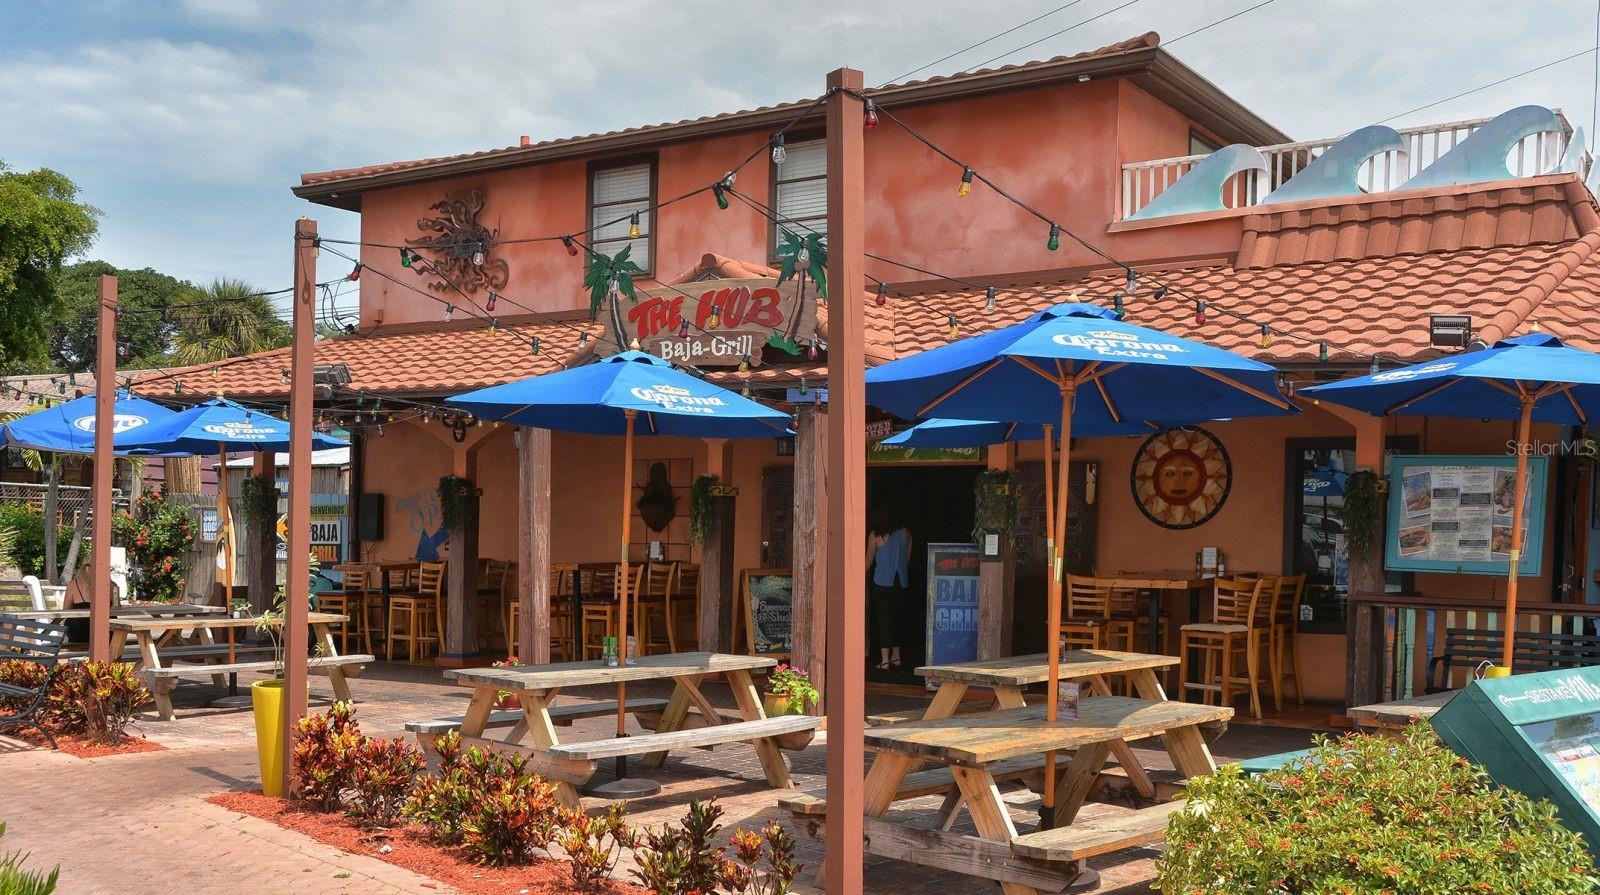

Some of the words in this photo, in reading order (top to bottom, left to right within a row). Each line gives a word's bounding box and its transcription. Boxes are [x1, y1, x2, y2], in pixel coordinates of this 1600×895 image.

[628, 296, 685, 340] THE
[695, 286, 784, 330] HUB
[659, 335, 753, 362] Baja-Grill
[1052, 334, 1190, 352] Corona
[1094, 346, 1169, 360] Extra
[631, 387, 728, 405] Corona
[660, 401, 714, 414] Extra
[312, 523, 338, 542] BAJA
[311, 546, 338, 562] GRILL
[936, 579, 980, 602] BAJ
